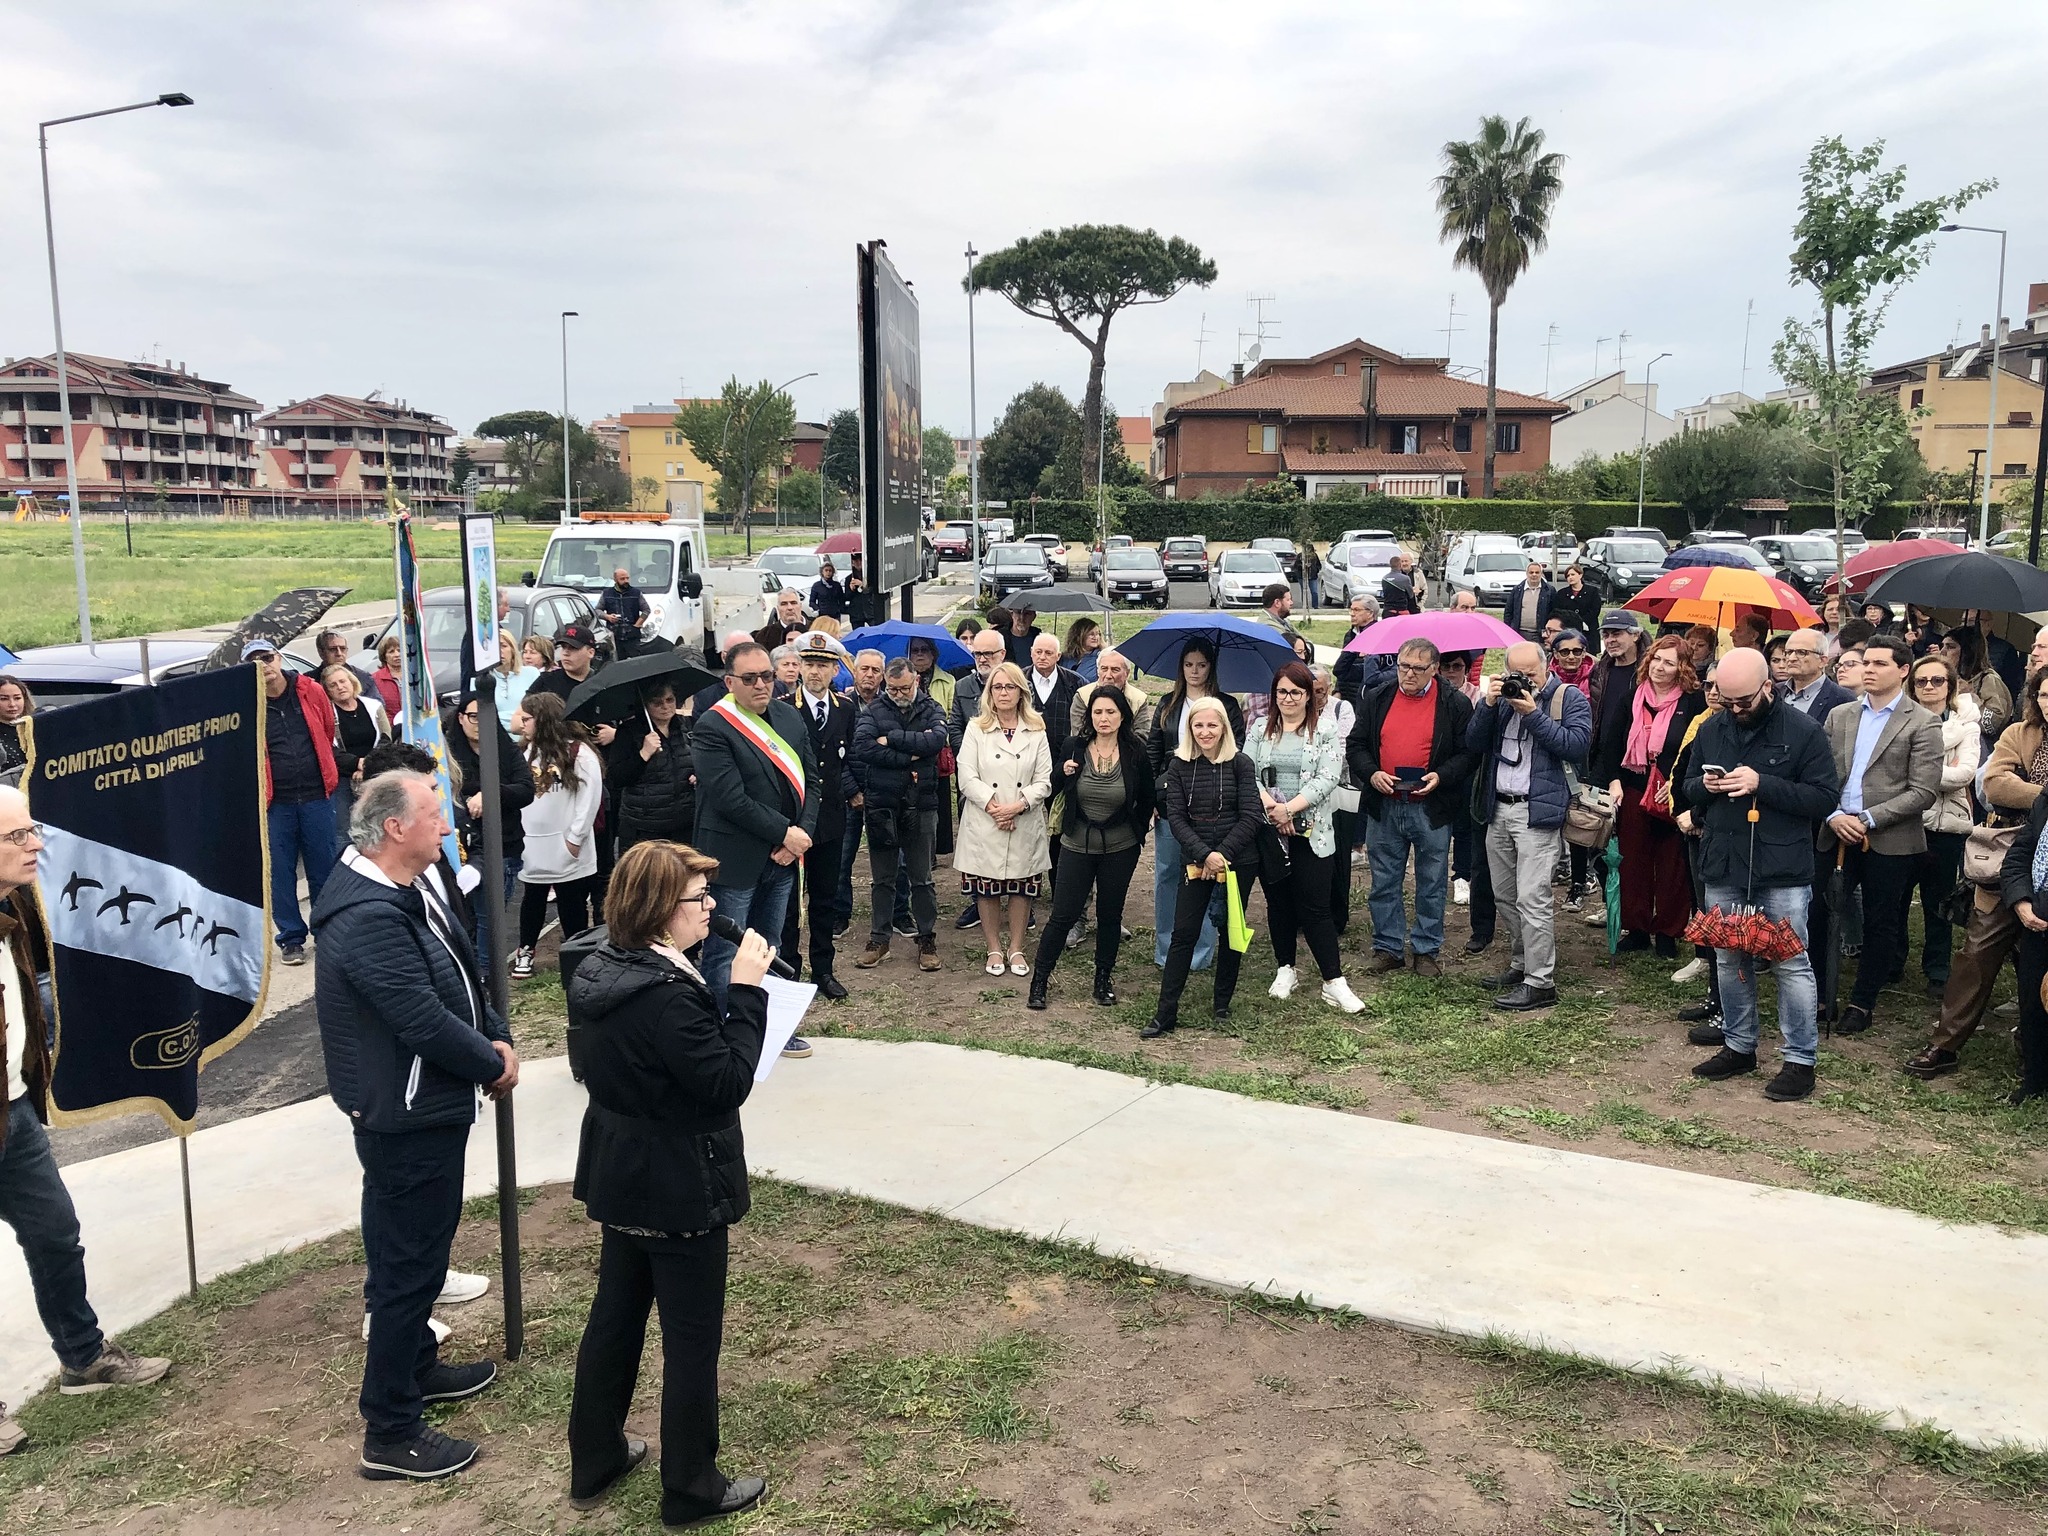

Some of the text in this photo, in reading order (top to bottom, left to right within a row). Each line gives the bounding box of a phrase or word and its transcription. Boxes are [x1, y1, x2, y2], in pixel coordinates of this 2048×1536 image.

[44, 712, 241, 780] COMITATO QUARTIERE PRIMO
[94, 747, 205, 791] CITTÀ DI APRILIA
